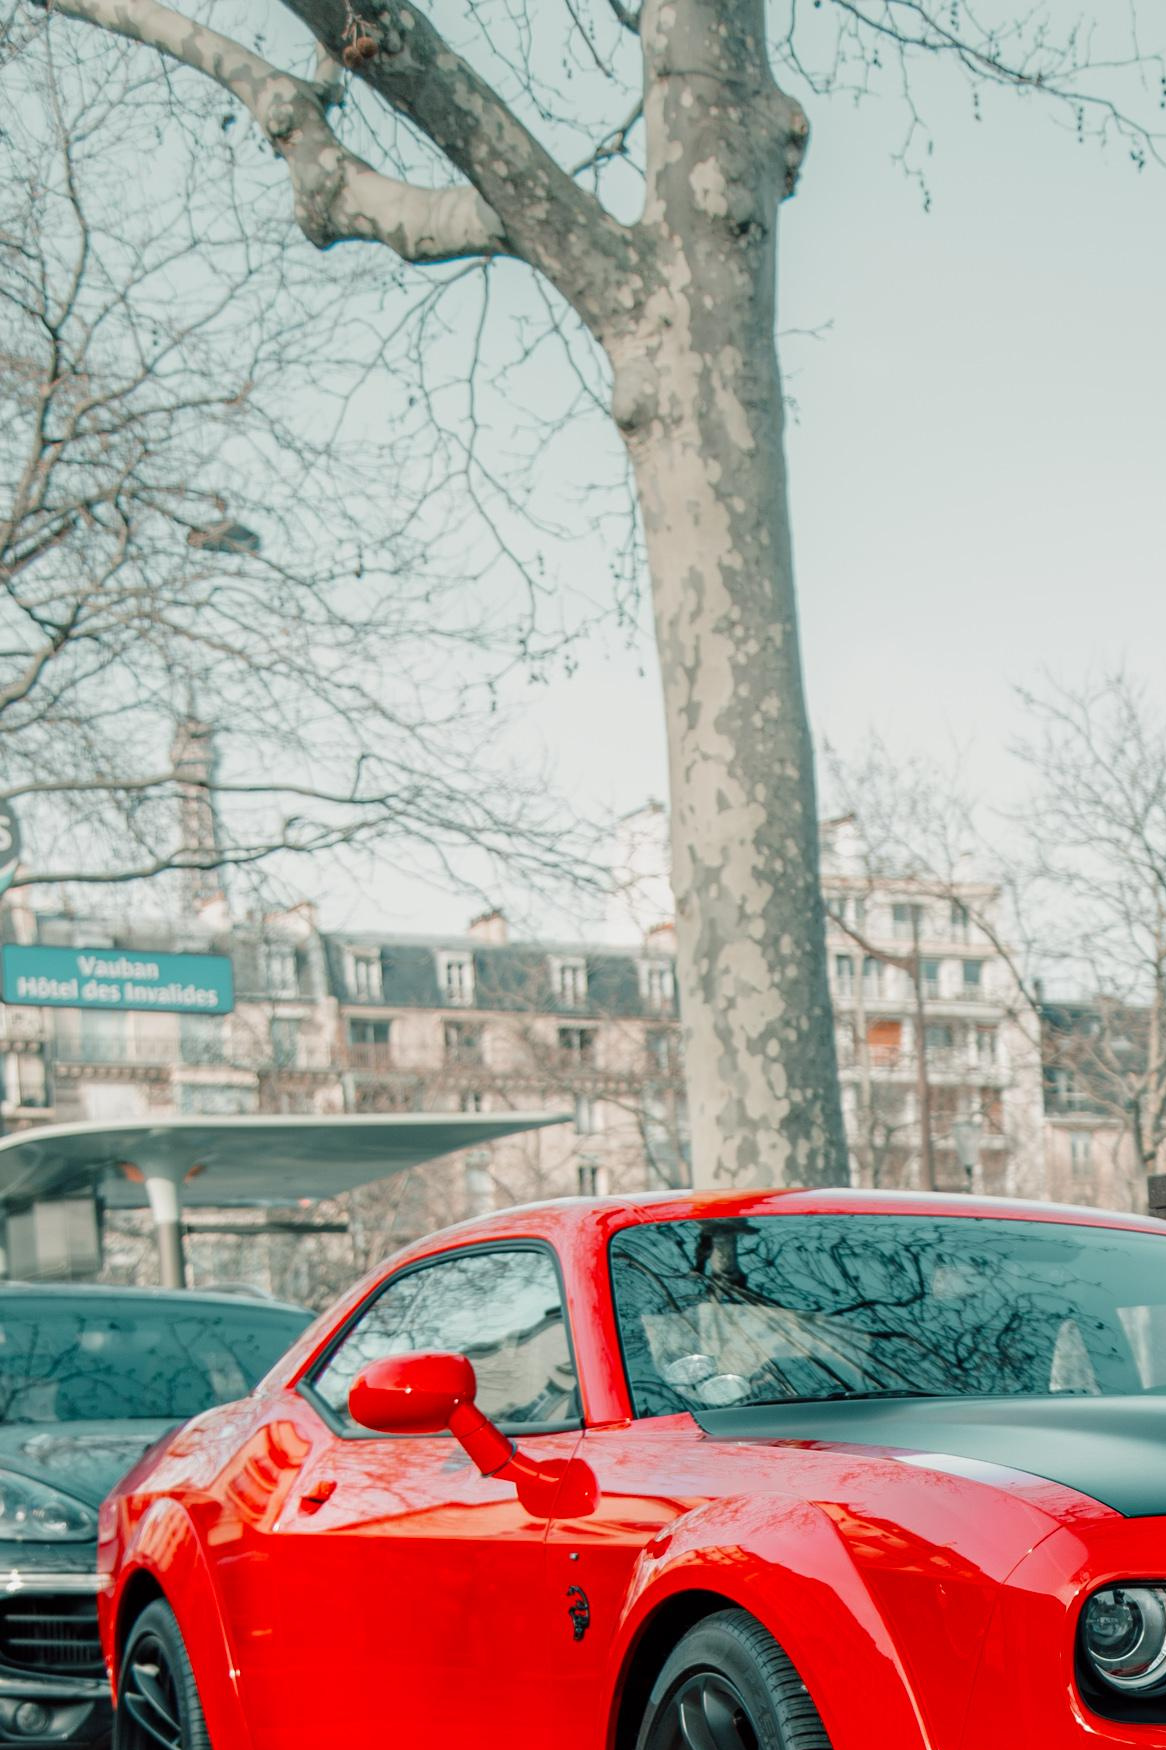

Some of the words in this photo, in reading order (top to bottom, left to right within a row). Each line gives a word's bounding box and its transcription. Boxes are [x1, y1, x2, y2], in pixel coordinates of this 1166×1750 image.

[77, 955, 159, 981] Vauban
[17, 976, 78, 1000] Hôtel
[82, 980, 121, 1004] des
[124, 982, 219, 1008] Invalides
